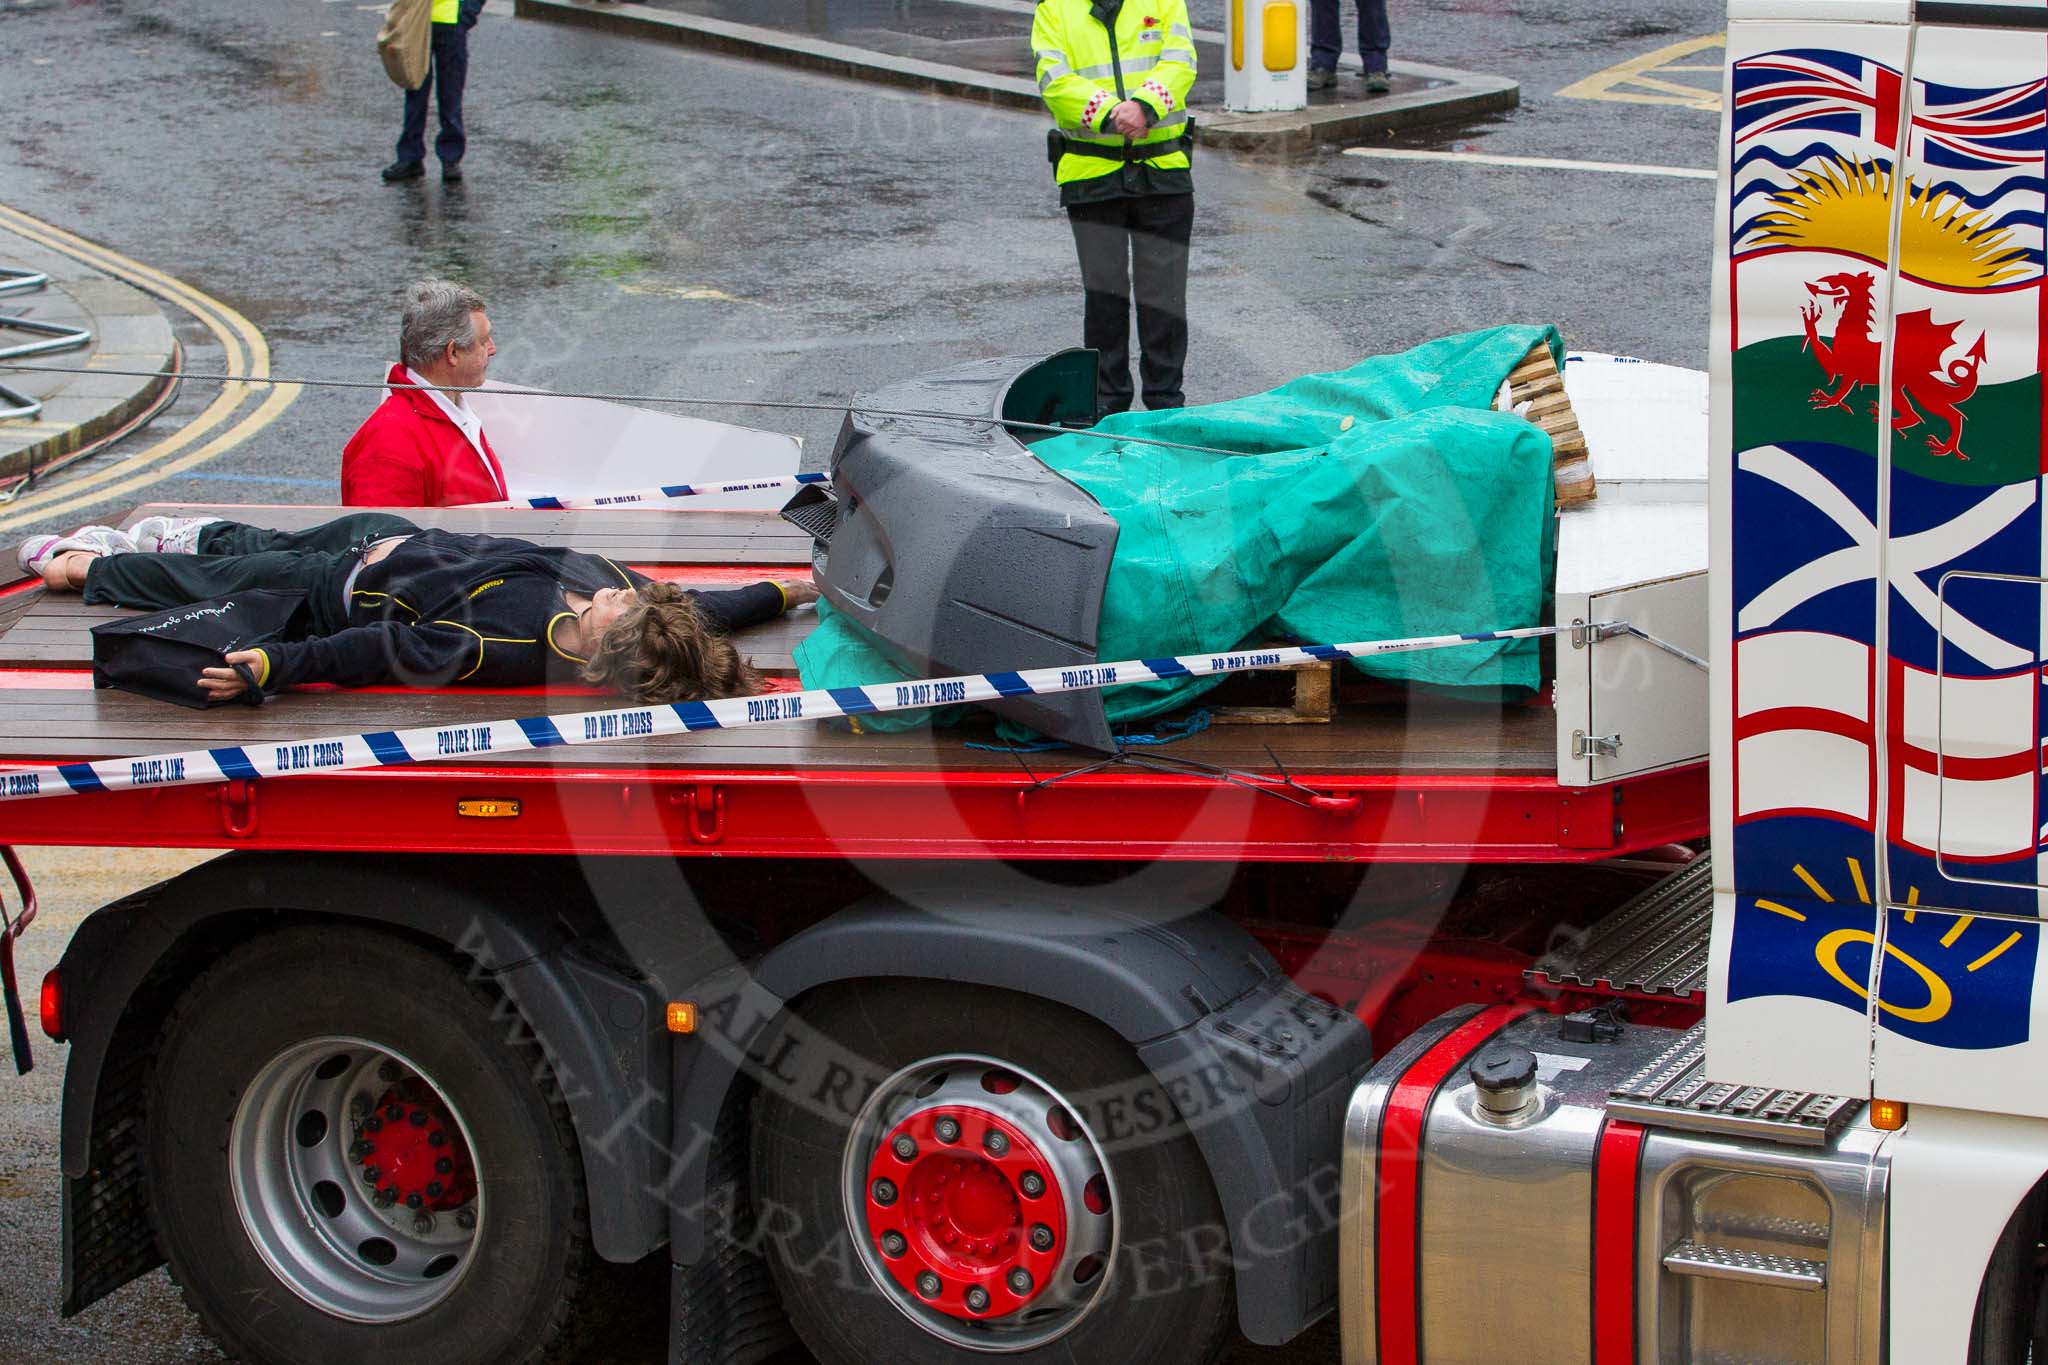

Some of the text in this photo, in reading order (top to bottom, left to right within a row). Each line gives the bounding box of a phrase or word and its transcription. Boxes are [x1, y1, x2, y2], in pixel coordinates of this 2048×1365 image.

[1211, 653, 1281, 670] DO NOT CROSS
[1061, 667, 1117, 689] POLICE LINE
[896, 681, 965, 706] DO NOT CROSS
[747, 696, 803, 722] POLICE LINE
[584, 711, 652, 739] DO NOT CROSS
[438, 727, 492, 754] POLICE LINE
[276, 742, 343, 770] DO NOT CROSS
[10, 773, 39, 794] CROSS
[132, 757, 185, 784] POLICE LINE
